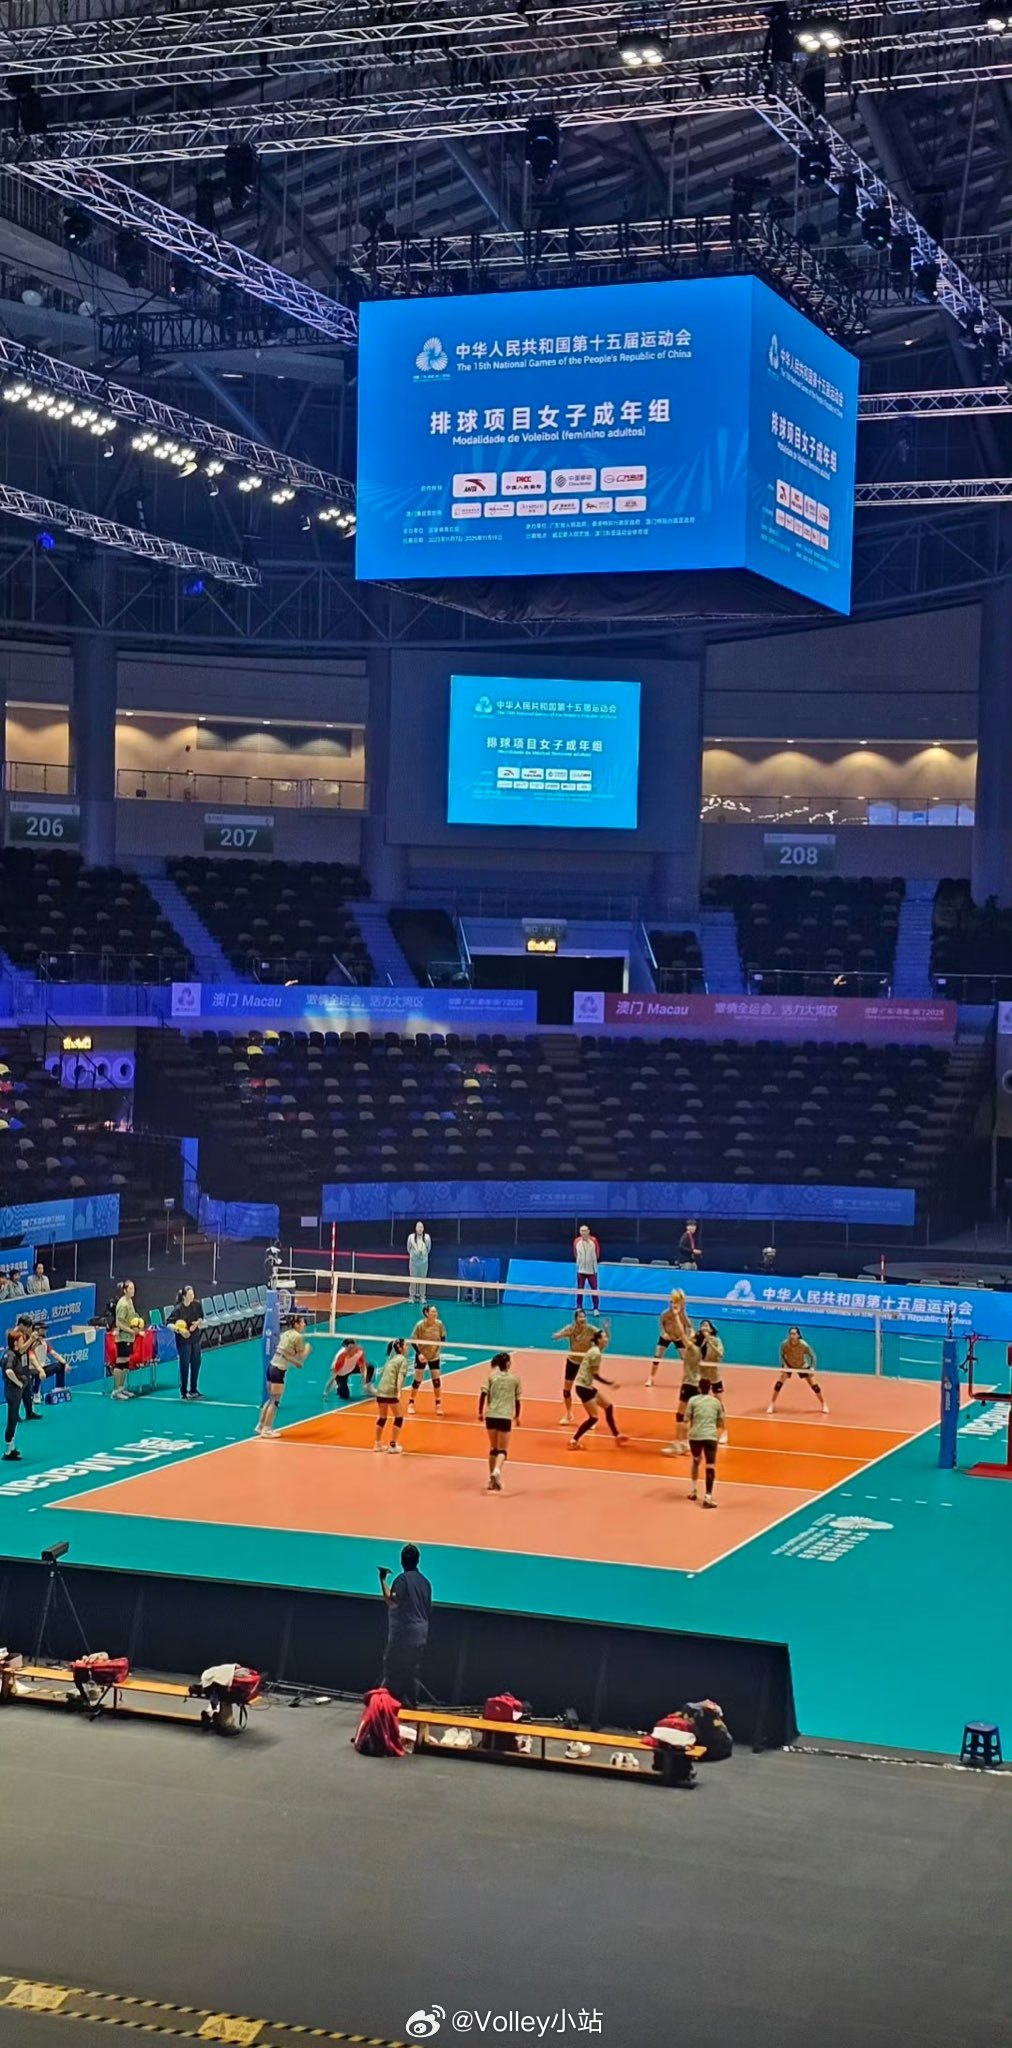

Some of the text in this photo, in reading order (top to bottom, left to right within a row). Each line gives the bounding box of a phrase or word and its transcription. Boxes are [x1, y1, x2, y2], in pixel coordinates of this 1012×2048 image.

[456, 328, 691, 359] 中华人民共和国第十五届运动会
[457, 349, 692, 372] The 15th National Games of the People's Republic of China
[430, 398, 670, 434] 排球项目女子成年组
[453, 426, 646, 446] Modalidade de Voleibol (feminino adultos)
[496, 700, 617, 713] 中华人民共和国第十五届运动会
[487, 737, 603, 752] 排球项目女子成年组
[26, 816, 64, 837] 206
[220, 828, 257, 847] 207
[780, 846, 818, 864] 208
[212, 992, 282, 1007] 澳门 Macau
[616, 1001, 689, 1015] 澳门 Macau
[763, 1286, 973, 1316] 中华人民共和国第十五届运动会
